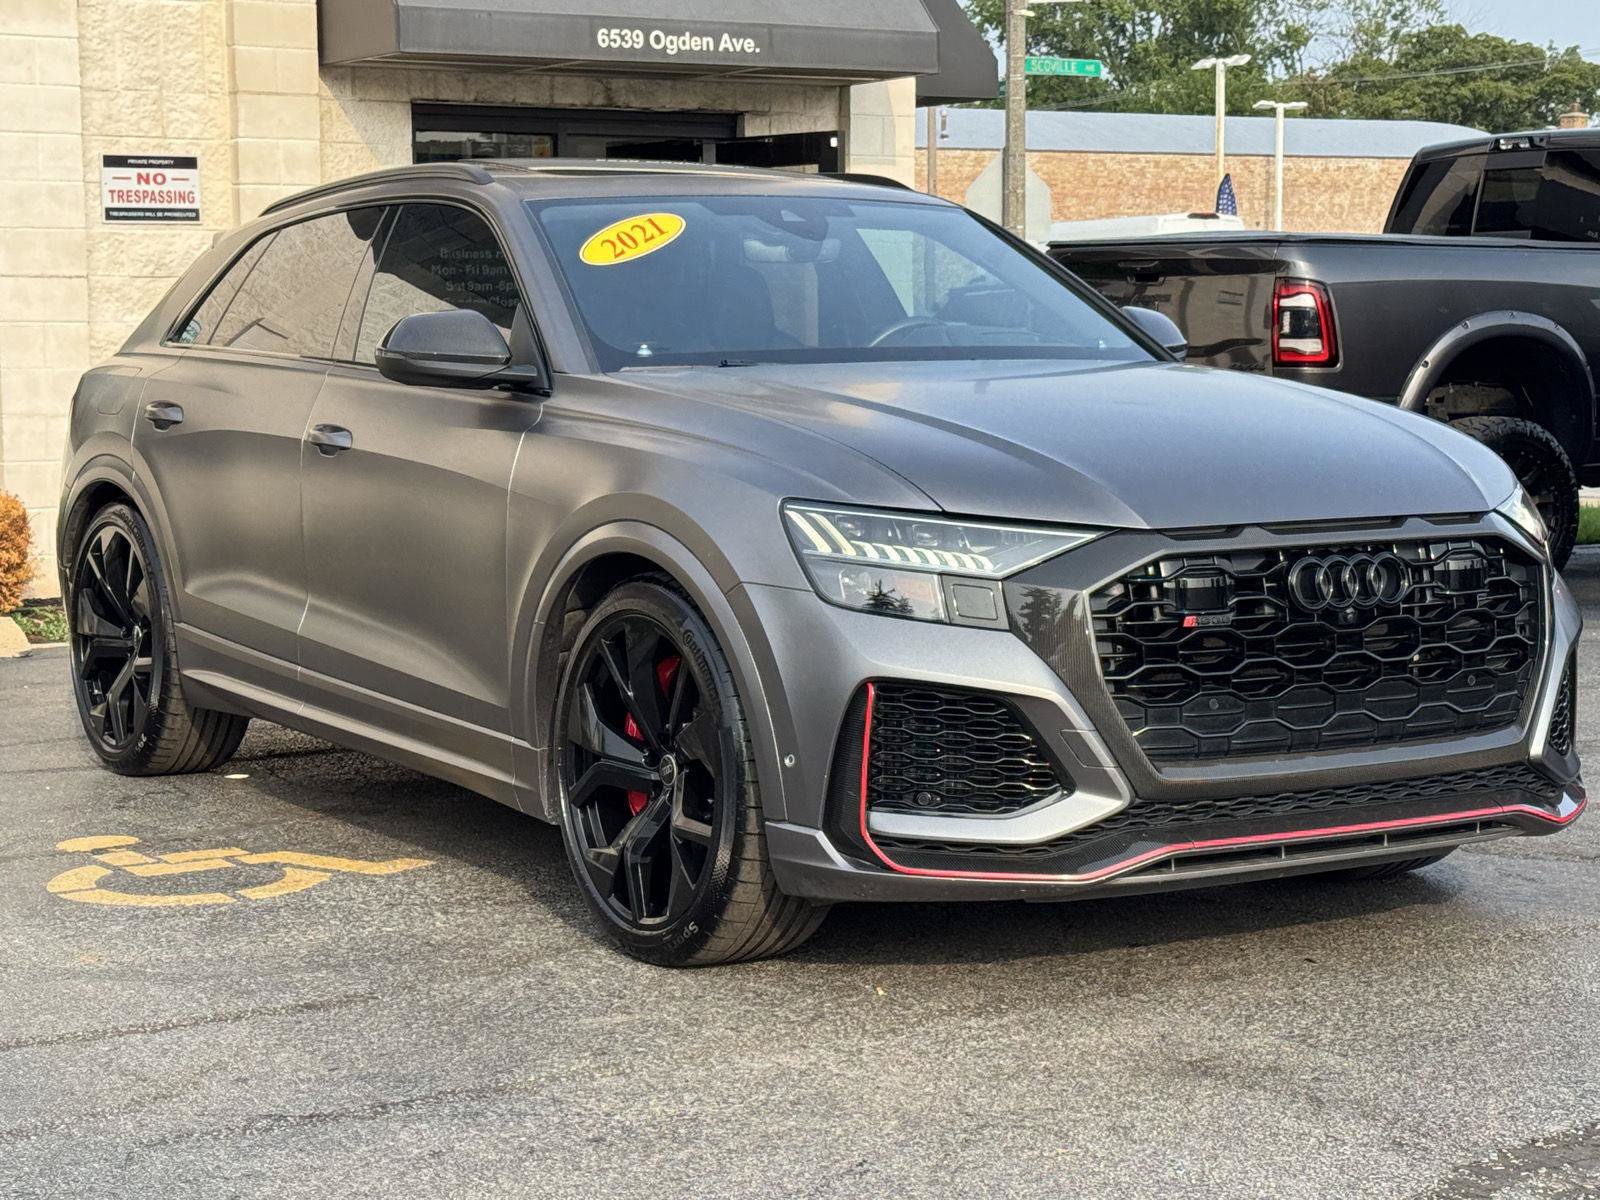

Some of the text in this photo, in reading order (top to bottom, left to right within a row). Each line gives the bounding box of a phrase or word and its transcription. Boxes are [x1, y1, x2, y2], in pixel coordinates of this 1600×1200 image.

[597, 28, 761, 55] 6539 Ogden Ave.
[1031, 60, 1077, 74] SCOVILLE
[136, 172, 167, 185] NO
[108, 189, 195, 204] TRESPASSING
[601, 218, 669, 259] 2021
[440, 248, 492, 260] Business
[431, 264, 457, 275] Mon
[465, 264, 480, 275] Fri
[482, 264, 509, 276] 9am
[446, 281, 466, 291] Sat
